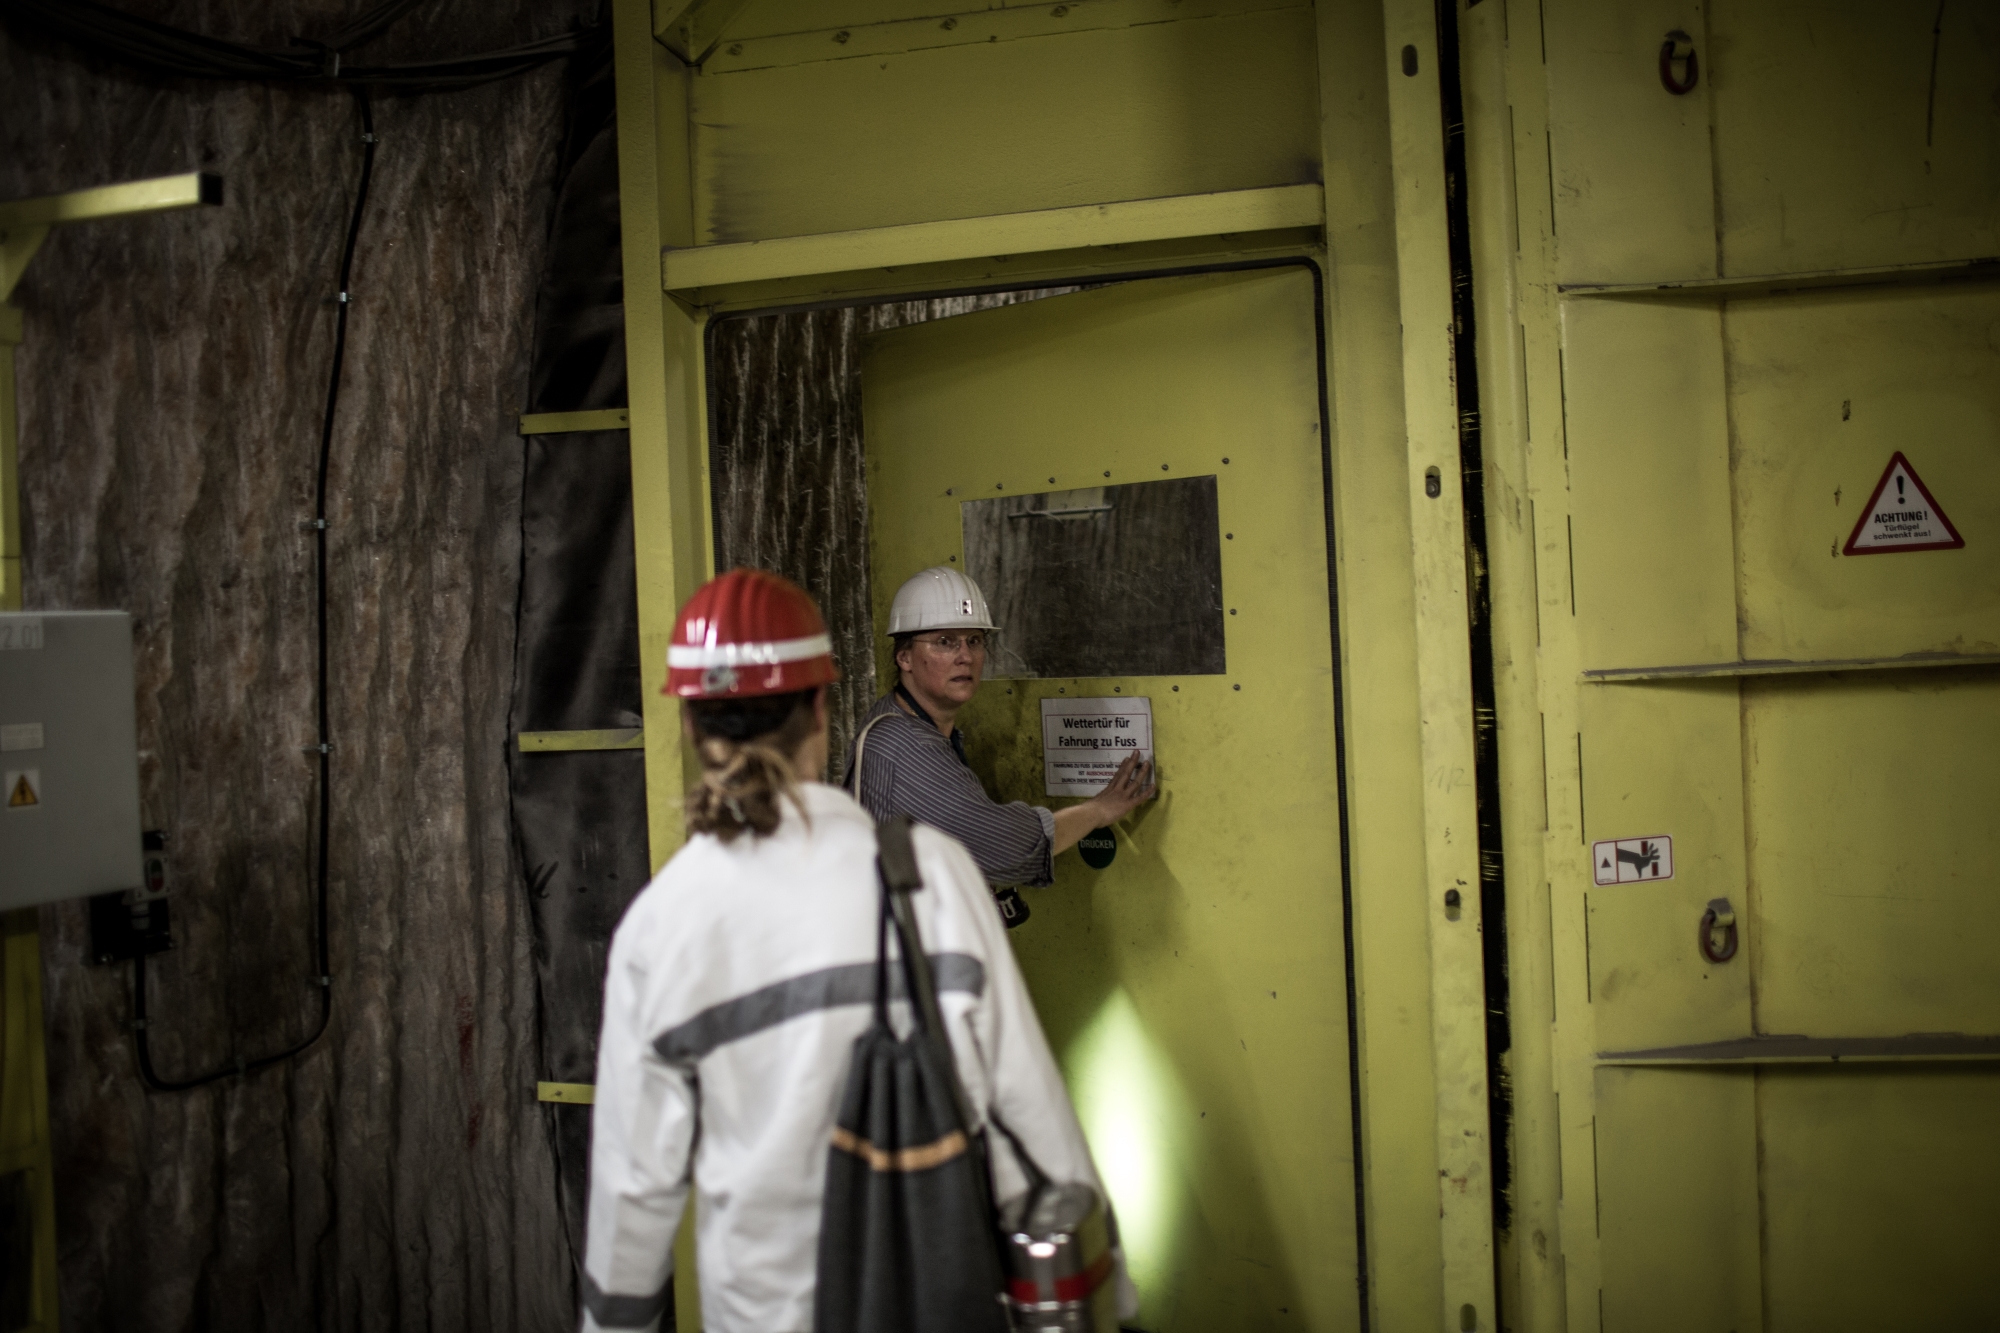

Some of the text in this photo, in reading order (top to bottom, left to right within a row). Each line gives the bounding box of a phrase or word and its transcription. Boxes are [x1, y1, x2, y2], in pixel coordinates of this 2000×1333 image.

[1884, 523, 1920, 532] Türflügel
[1873, 530, 1931, 540] schwenkt aus!
[1063, 717, 1130, 729] Wettertür für
[1058, 736, 1137, 749] Fahrung zu Fuss
[1080, 837, 1115, 849] DRÜCKEN
